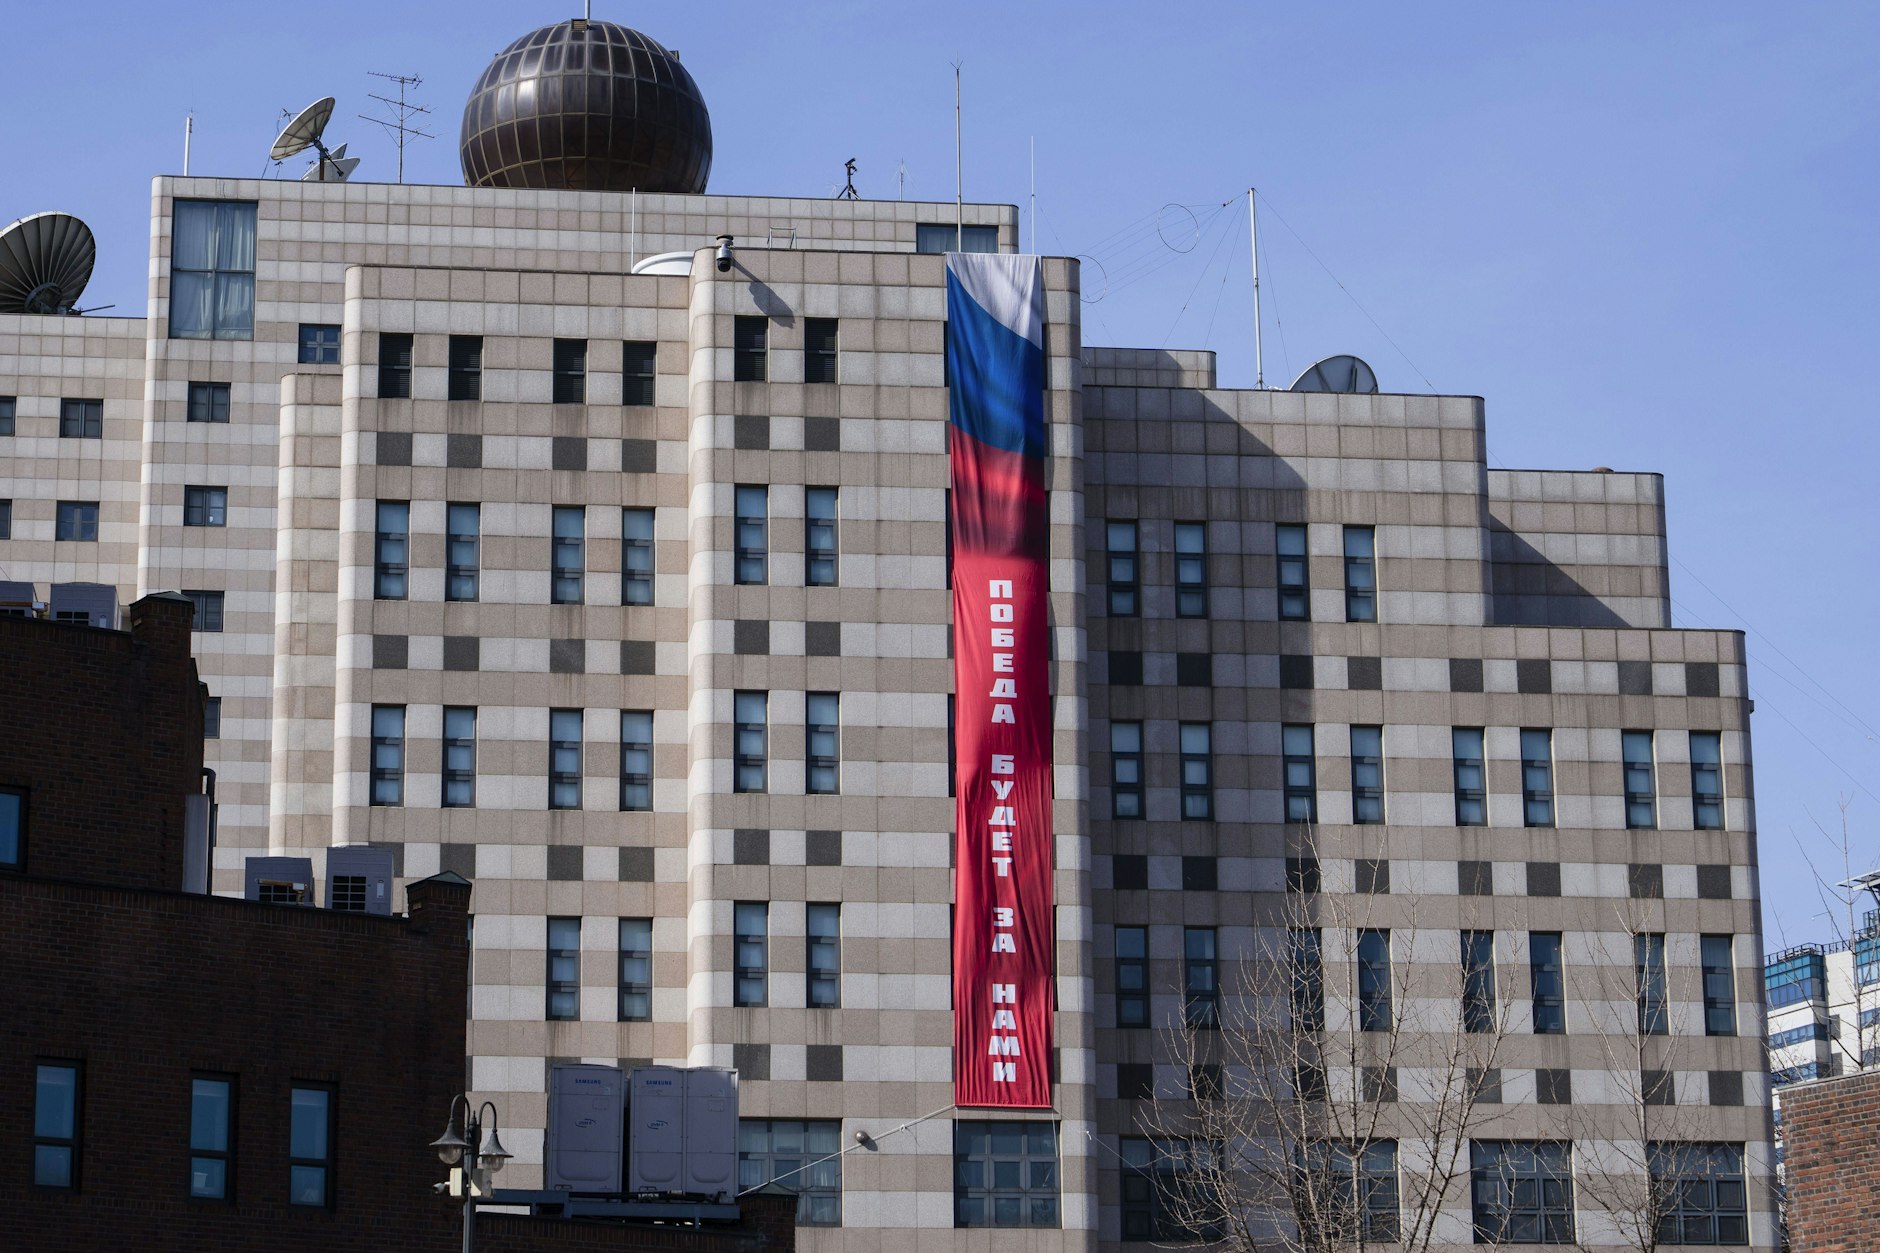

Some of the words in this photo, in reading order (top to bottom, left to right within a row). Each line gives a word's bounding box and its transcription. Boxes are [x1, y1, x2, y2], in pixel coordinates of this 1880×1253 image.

[989, 580, 1017, 724] ПОБЕДА
[988, 754, 1016, 877] БУДЕТ
[991, 907, 1016, 953] ЗА
[988, 983, 1021, 1082] НАМИ
